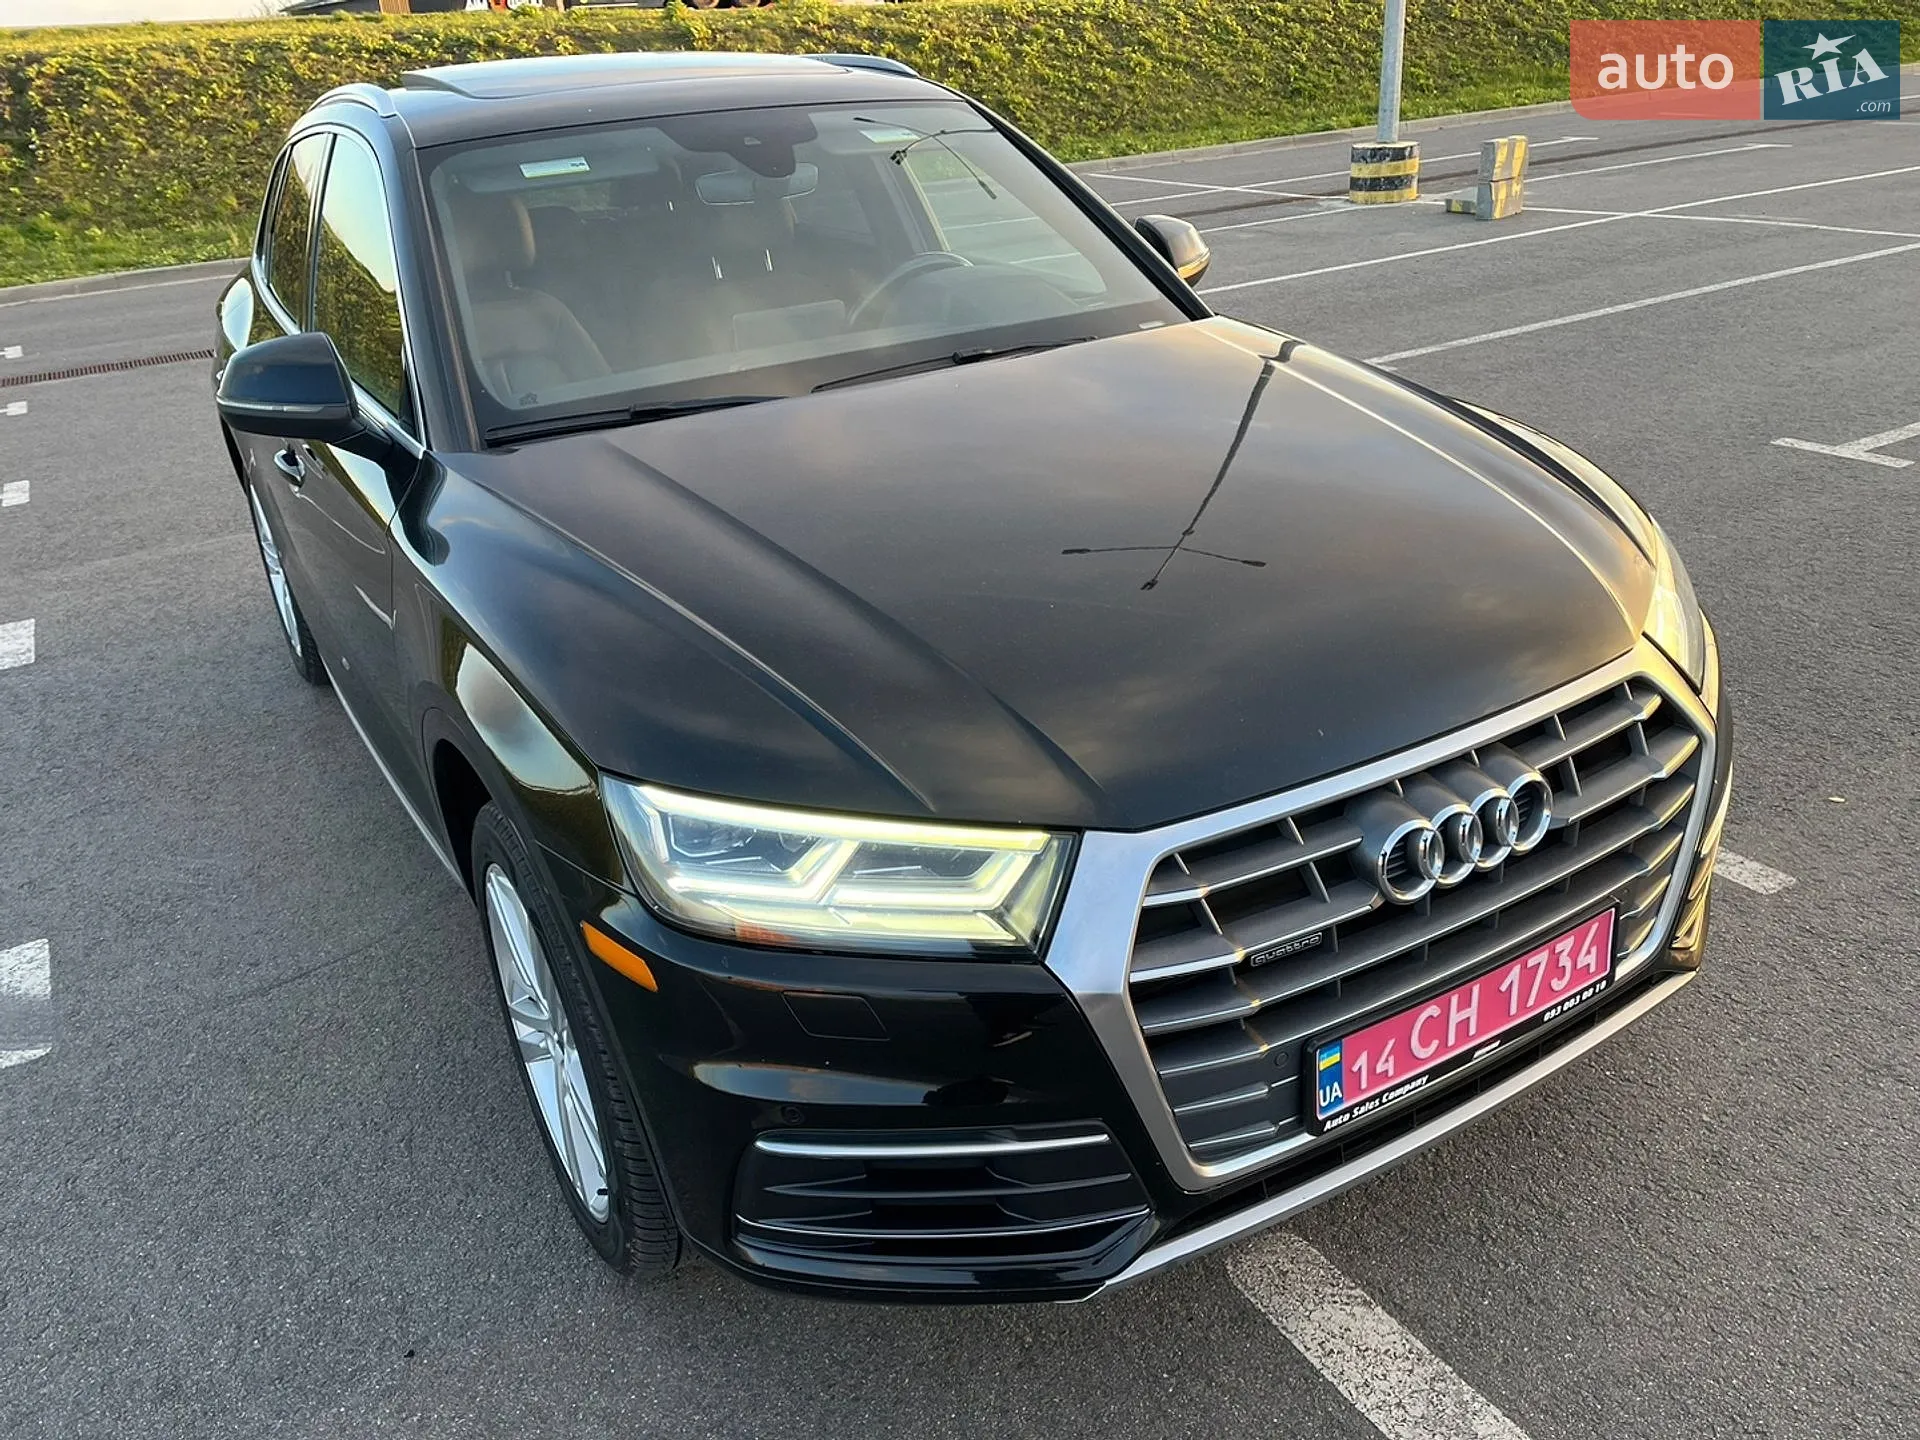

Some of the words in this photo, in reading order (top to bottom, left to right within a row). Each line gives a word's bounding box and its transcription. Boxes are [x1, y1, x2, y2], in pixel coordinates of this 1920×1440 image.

[1255, 936, 1320, 964] quattro
[1351, 1038, 1396, 1090] 14
[1410, 984, 1480, 1060] CH
[1499, 922, 1599, 1016] 1734
[1320, 1081, 1343, 1107] UA
[1323, 1111, 1351, 1132] Auto
[1352, 1098, 1380, 1118] Sales
[1382, 1074, 1429, 1104] Company
